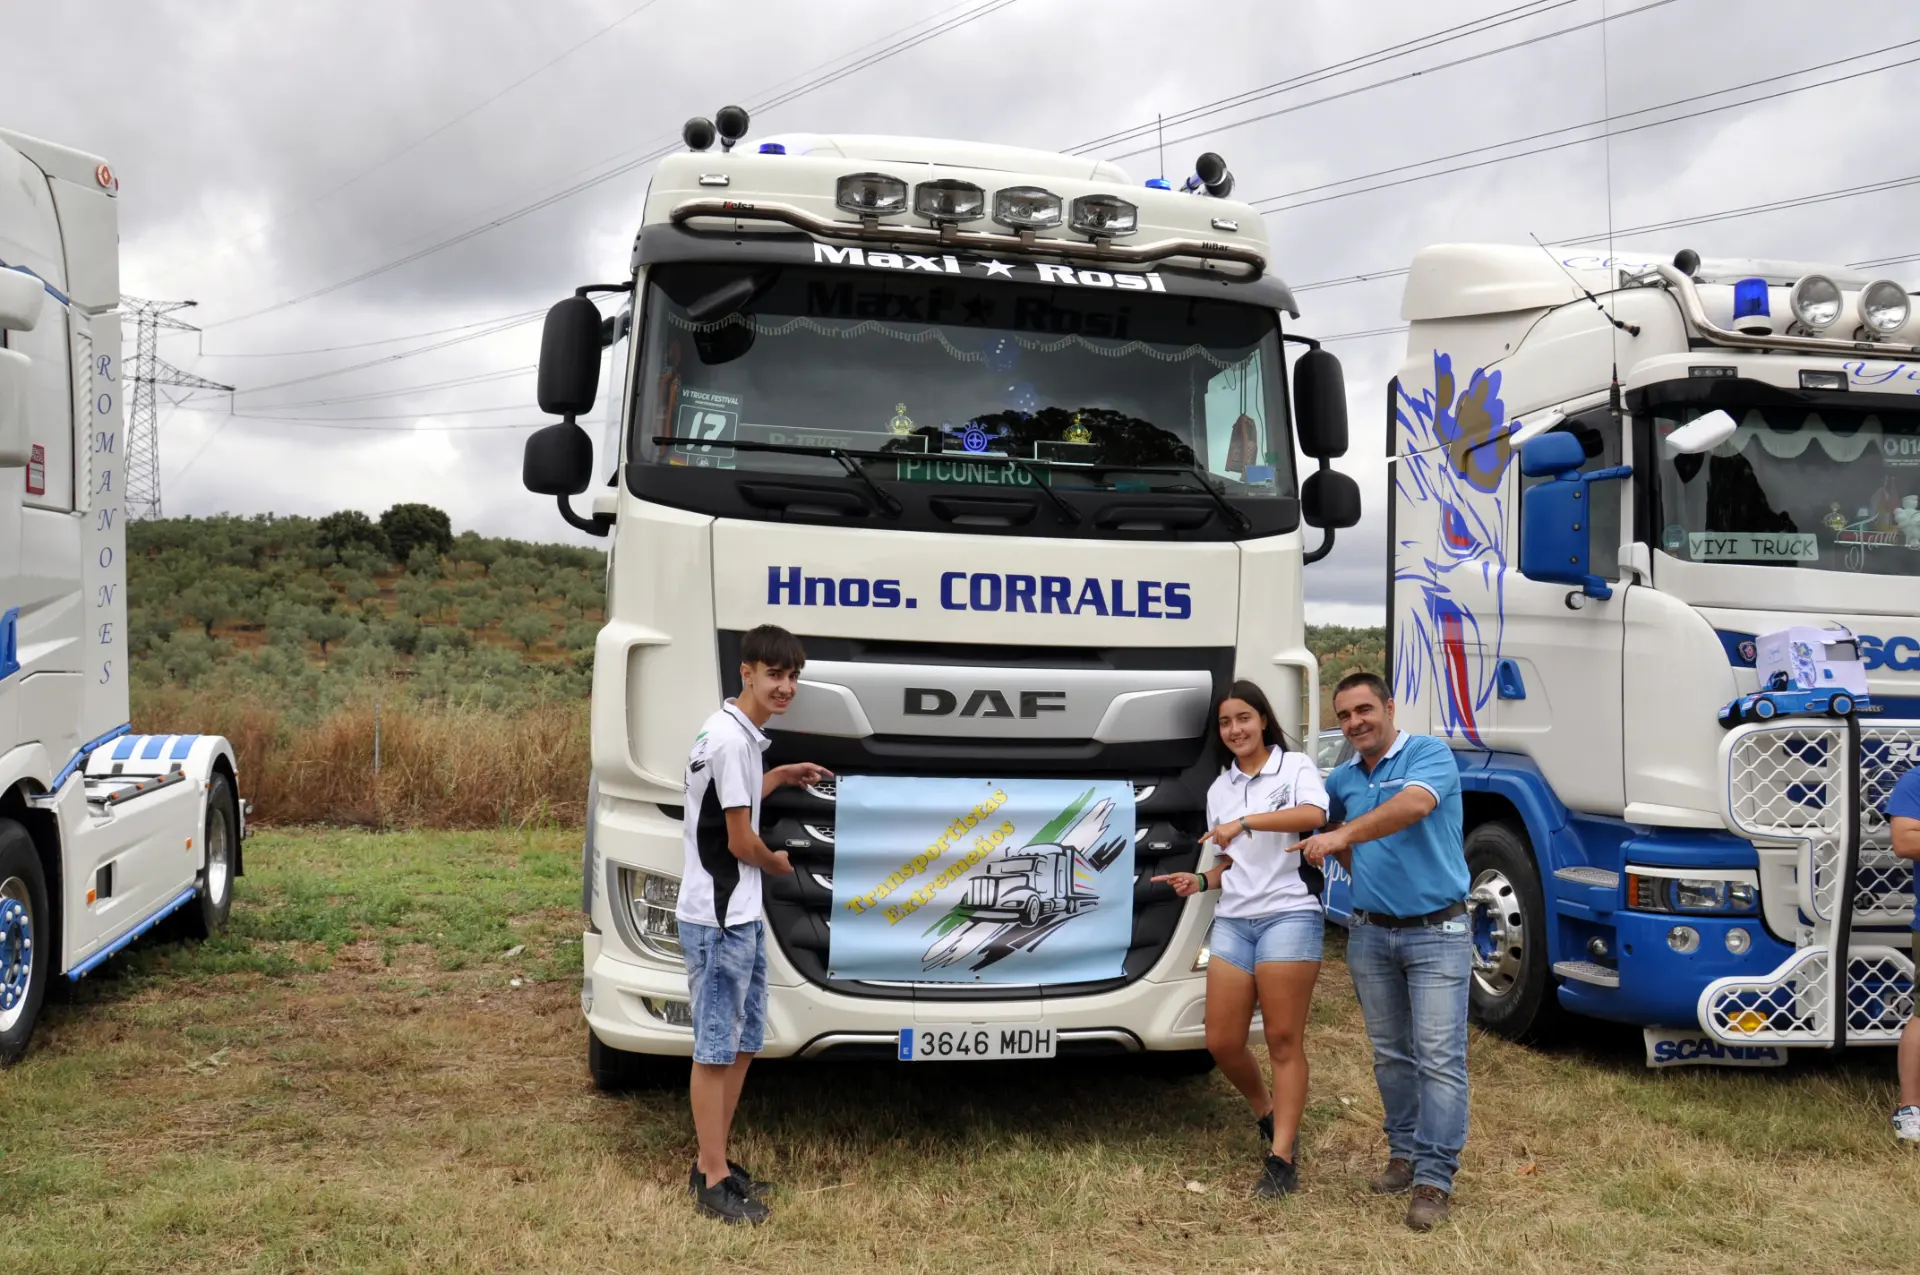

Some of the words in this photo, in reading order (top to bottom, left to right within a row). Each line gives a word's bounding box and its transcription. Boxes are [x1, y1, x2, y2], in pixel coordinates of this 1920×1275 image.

[723, 201, 755, 211] Kelsa
[813, 242, 962, 274] Maxi
[1034, 262, 1168, 293] Rosi
[690, 390, 711, 402] TRUCK
[711, 394, 739, 405] FESTIVAL
[686, 411, 727, 453] 17
[95, 354, 117, 684] ROMANONES
[1690, 538, 1738, 556] YIYI
[1751, 538, 1814, 557] TRUCK
[767, 565, 918, 609] Hnos.
[940, 571, 1192, 620] CORRALES
[903, 686, 1067, 720] DAF
[844, 789, 1009, 916] Transportistas
[882, 820, 1016, 926] Extremeños
[920, 1031, 989, 1056] 3646
[1000, 1029, 1051, 1055] MDH
